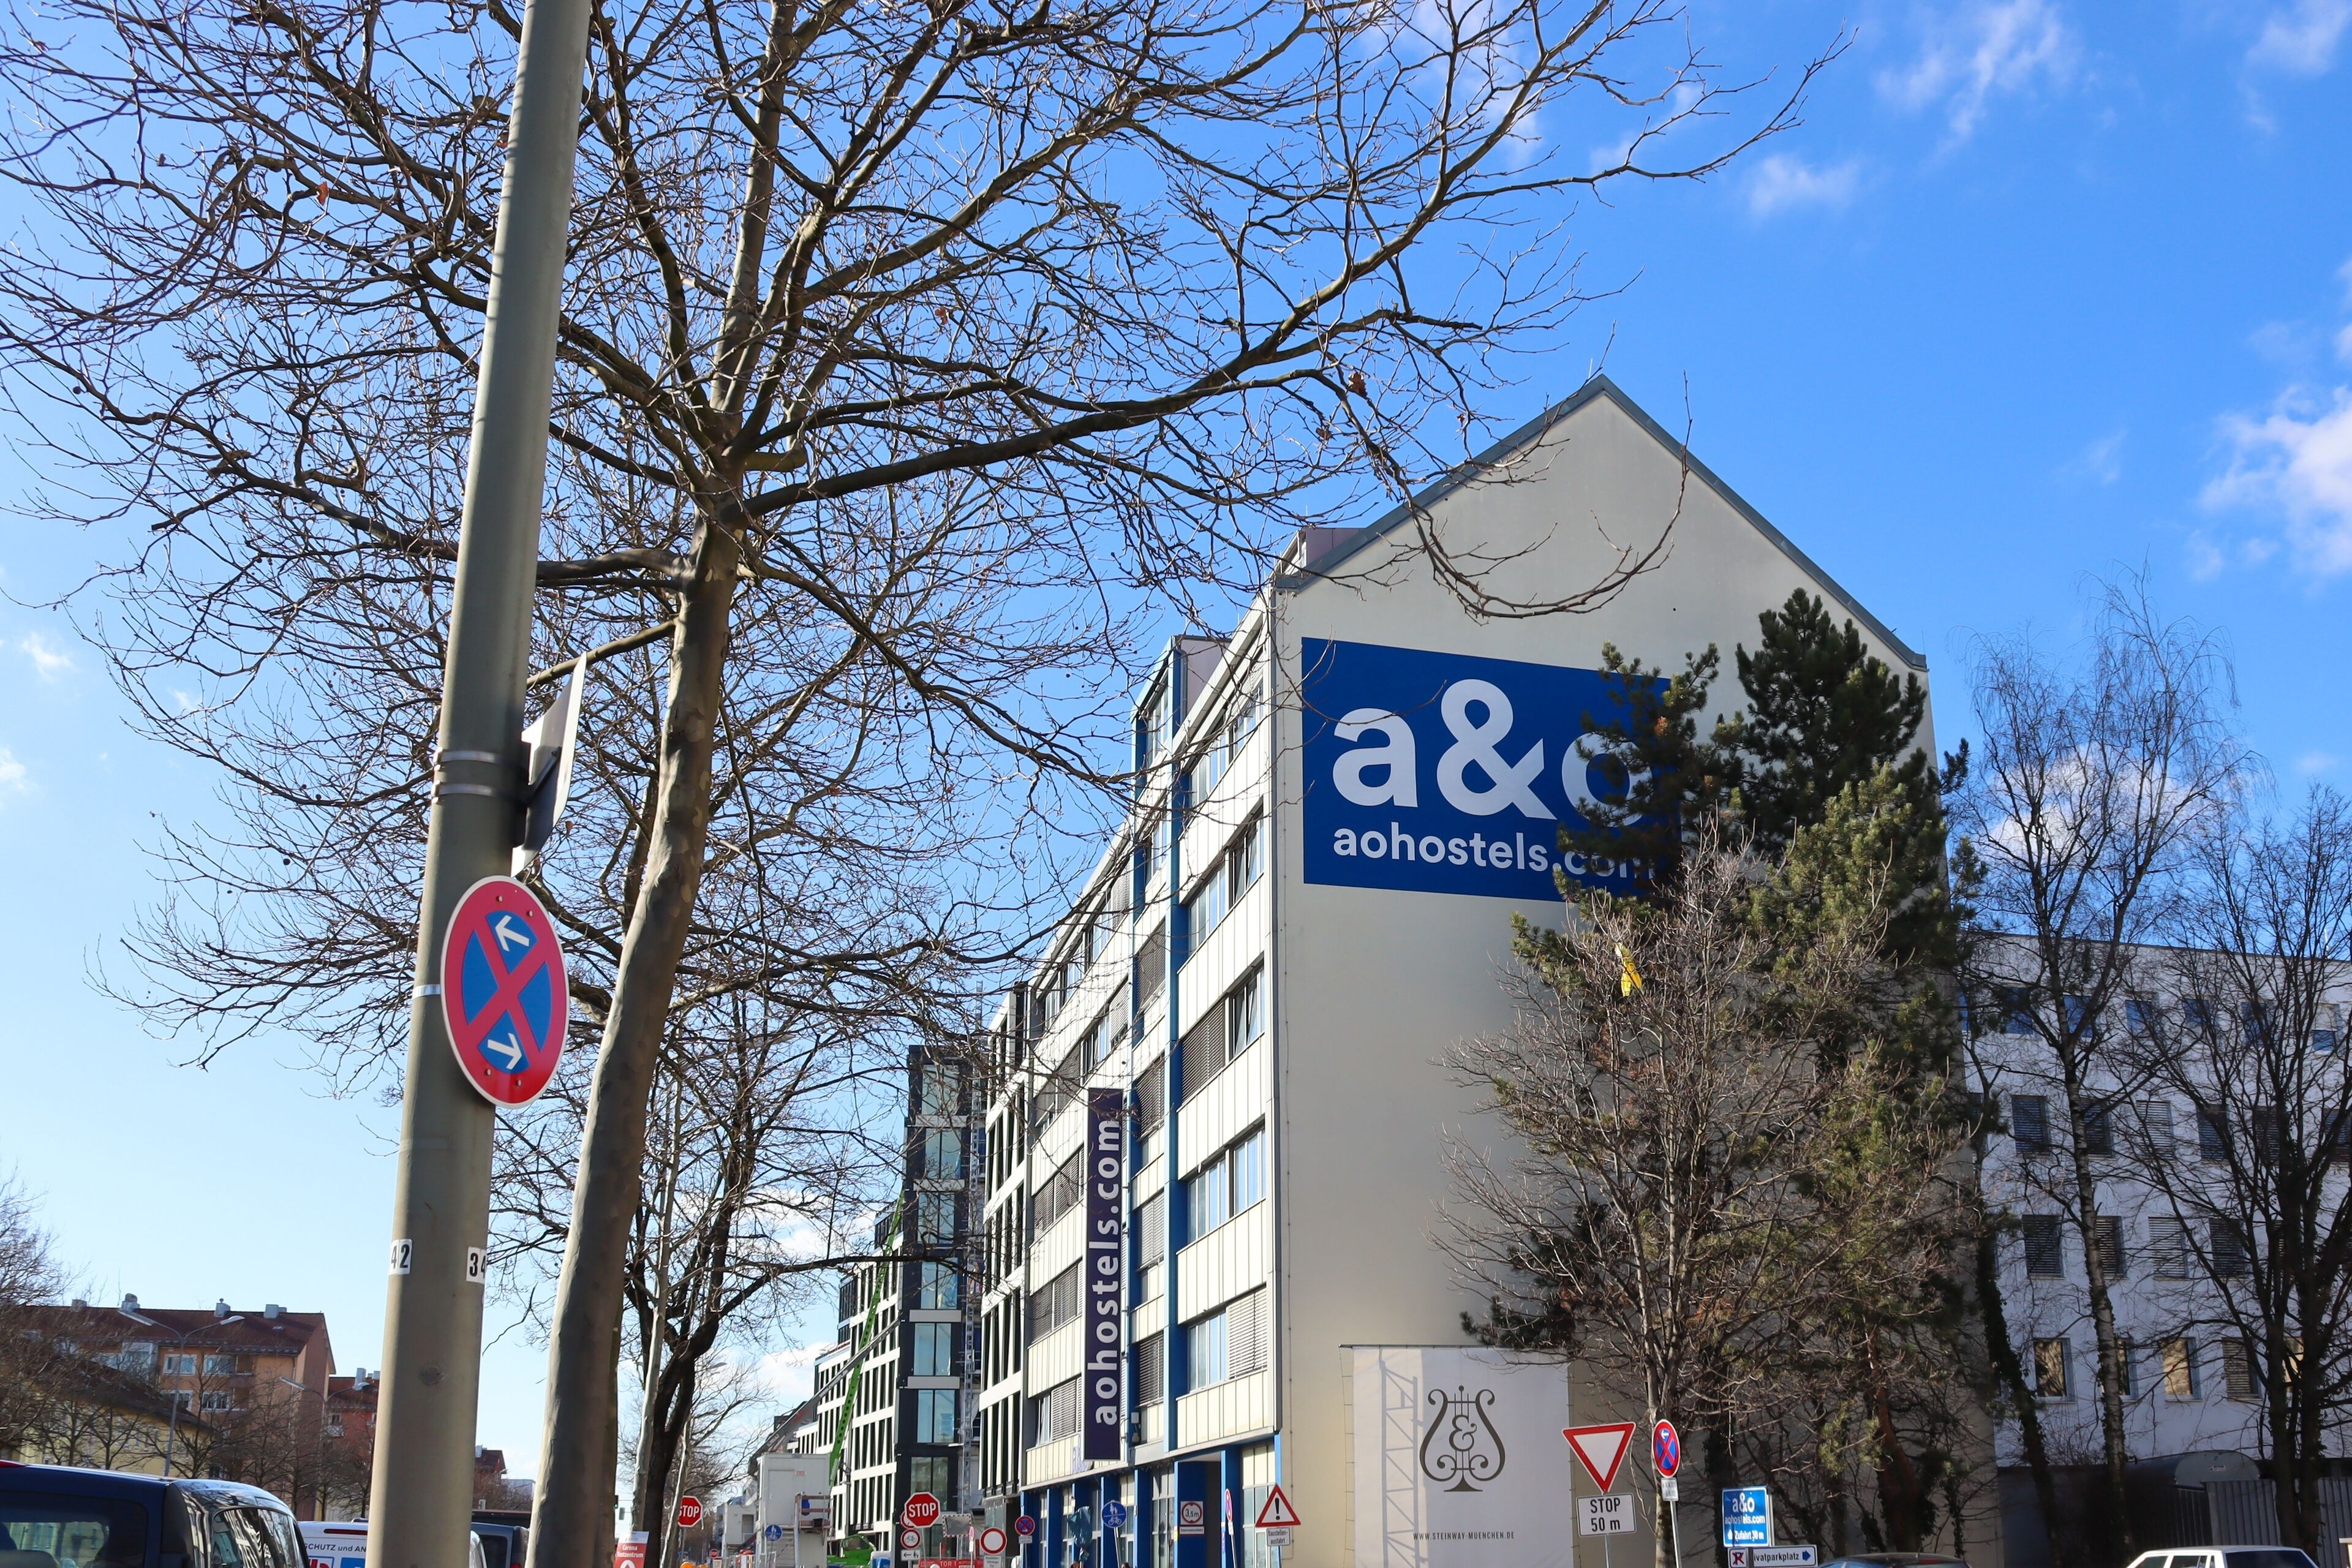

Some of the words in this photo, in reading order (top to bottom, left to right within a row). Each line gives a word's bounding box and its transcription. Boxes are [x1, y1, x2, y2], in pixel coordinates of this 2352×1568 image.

[391, 1244, 410, 1269] 42
[1087, 1120, 1120, 1426] aohostels.com
[908, 1502, 937, 1518] STOP
[1590, 1498, 1621, 1513] STOP
[1732, 1492, 1755, 1513] a&o
[1591, 1518, 1605, 1531] 50
[1610, 1520, 1621, 1531] m
[1725, 1513, 1765, 1525] aohostels.com
[1413, 1531, 1515, 1540] WWW.STEINWAY-MUENCHEN.DE
[1735, 1529, 1752, 1540] Zufahrt
[1758, 1531, 1765, 1540] m
